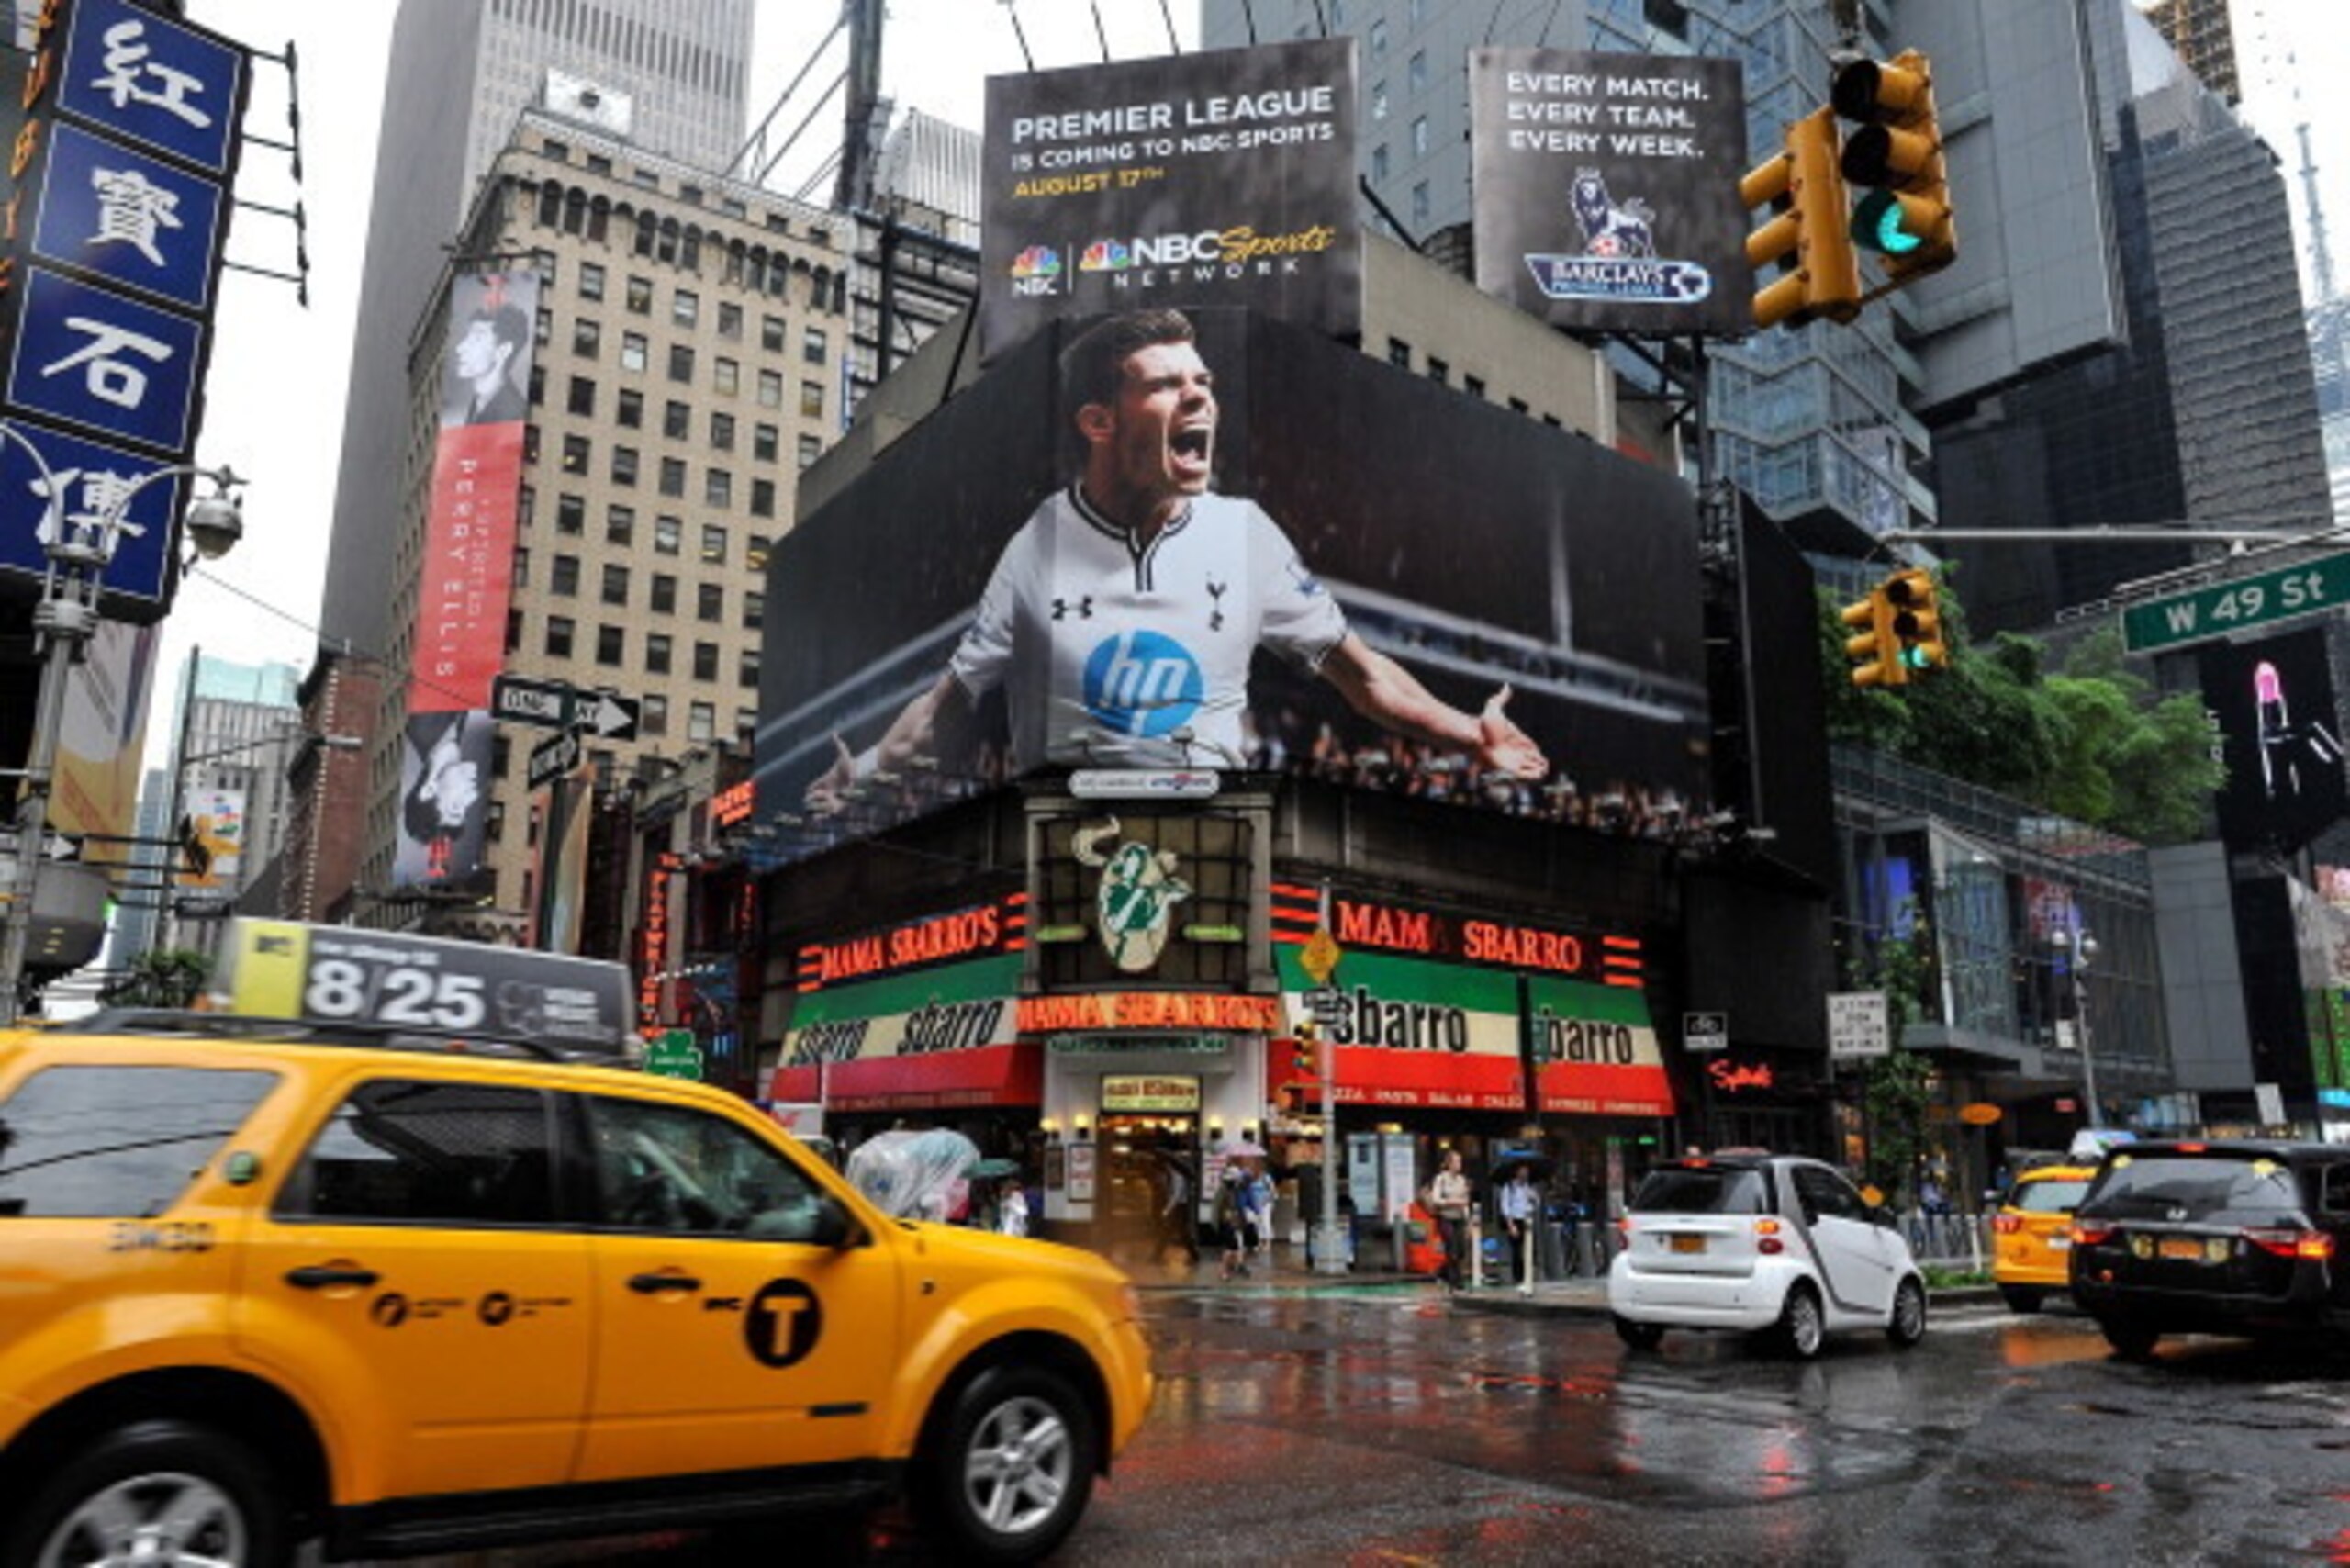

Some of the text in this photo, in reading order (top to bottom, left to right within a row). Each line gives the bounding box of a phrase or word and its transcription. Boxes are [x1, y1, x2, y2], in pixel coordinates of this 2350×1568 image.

[1507, 72, 1709, 101] EVERY MATCH.
[1012, 86, 1334, 143] PREMIER LEAGUE
[1506, 101, 1695, 128] EVERY TEAM.
[1012, 122, 1335, 172] IS COMING TO NBC SPORTS
[1507, 129, 1705, 158] EVERY WEEK.
[1013, 171, 1113, 197] AUGUST
[1131, 224, 1337, 267] NBC Sports
[1013, 277, 1058, 296] NBC
[1113, 259, 1301, 286] NETWORK
[1552, 261, 1665, 284] BARCLAYS
[435, 458, 478, 676] PERRY ELLIS
[2165, 570, 2324, 634] W 49 St
[1102, 628, 1189, 740] hp
[822, 905, 998, 980] MAMA SBARRO'S
[1463, 919, 1582, 972] SBARRO
[897, 1000, 1004, 1056] sbarro
